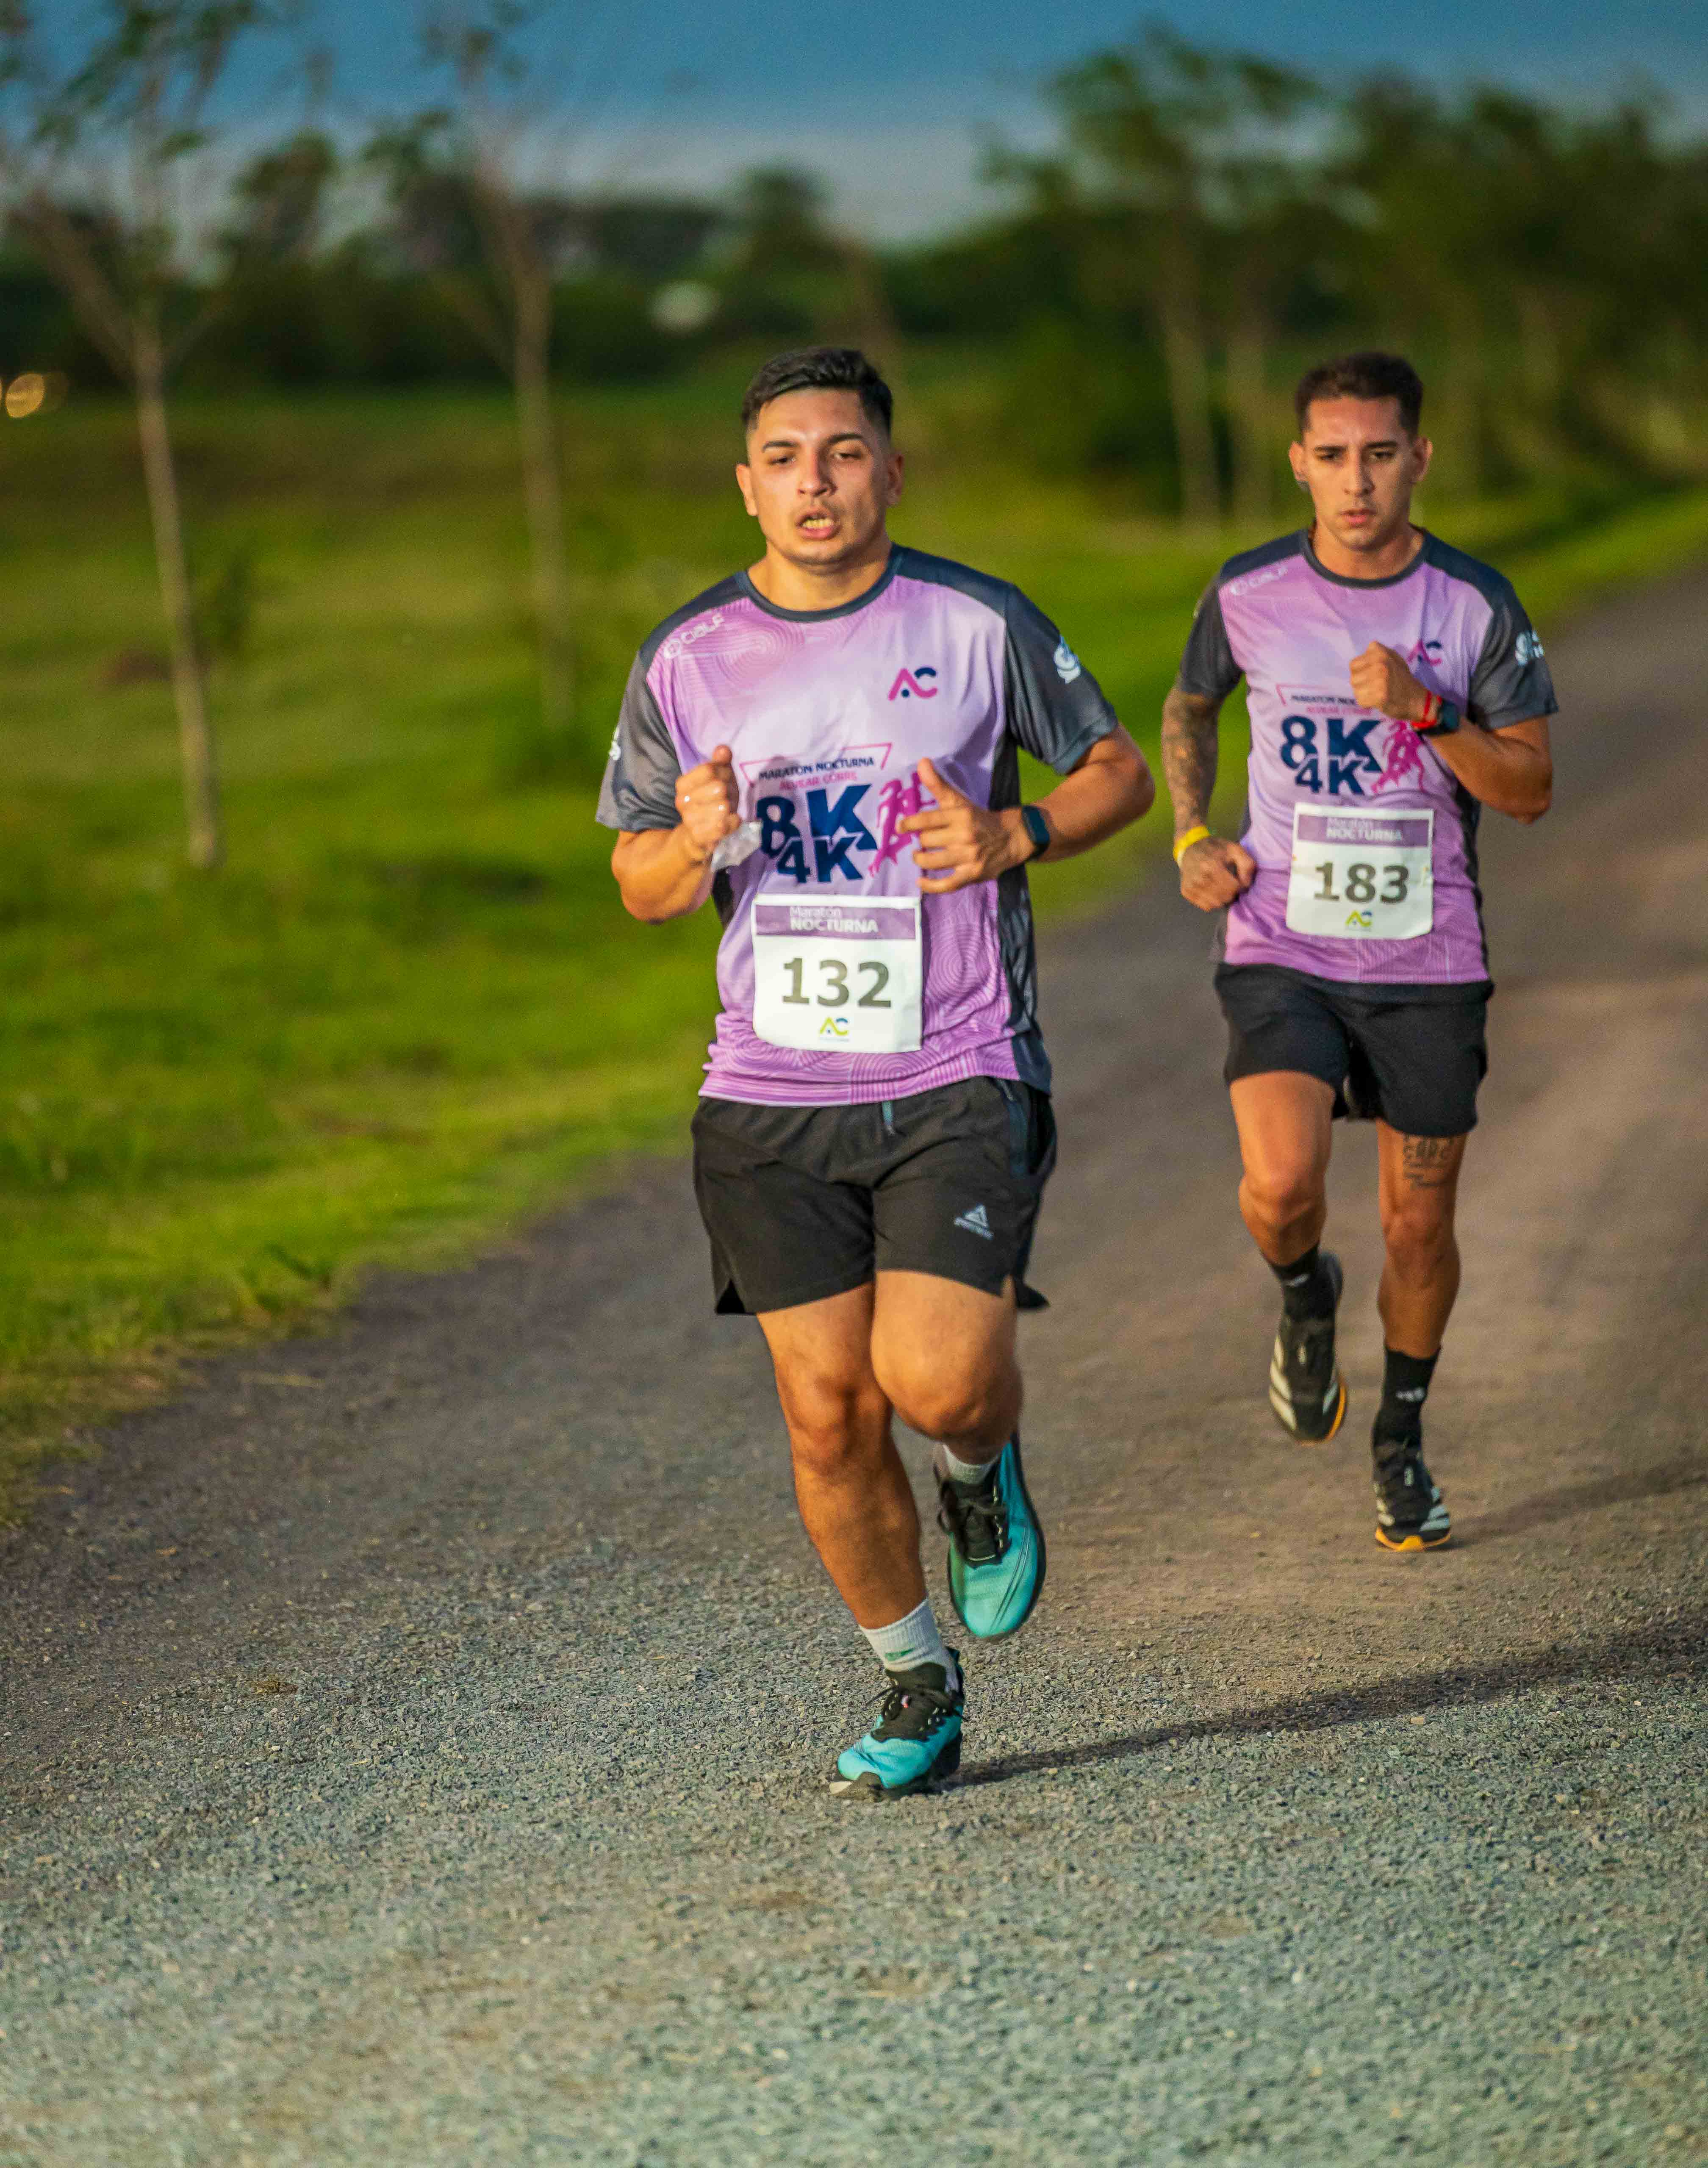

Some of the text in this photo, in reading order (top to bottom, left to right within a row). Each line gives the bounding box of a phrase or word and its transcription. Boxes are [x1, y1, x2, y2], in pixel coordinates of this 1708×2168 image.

[888, 667, 938, 701] AC
[1281, 715, 1383, 773] 8K
[815, 757, 874, 772] NOCTURNA
[1294, 758, 1365, 795] 4K
[756, 784, 878, 859] 8K
[1326, 827, 1403, 841] NOCTURNA
[776, 835, 863, 884] 4K
[1314, 862, 1409, 904] 183
[790, 918, 878, 933] NOCTURNA
[782, 957, 892, 1008] 132
